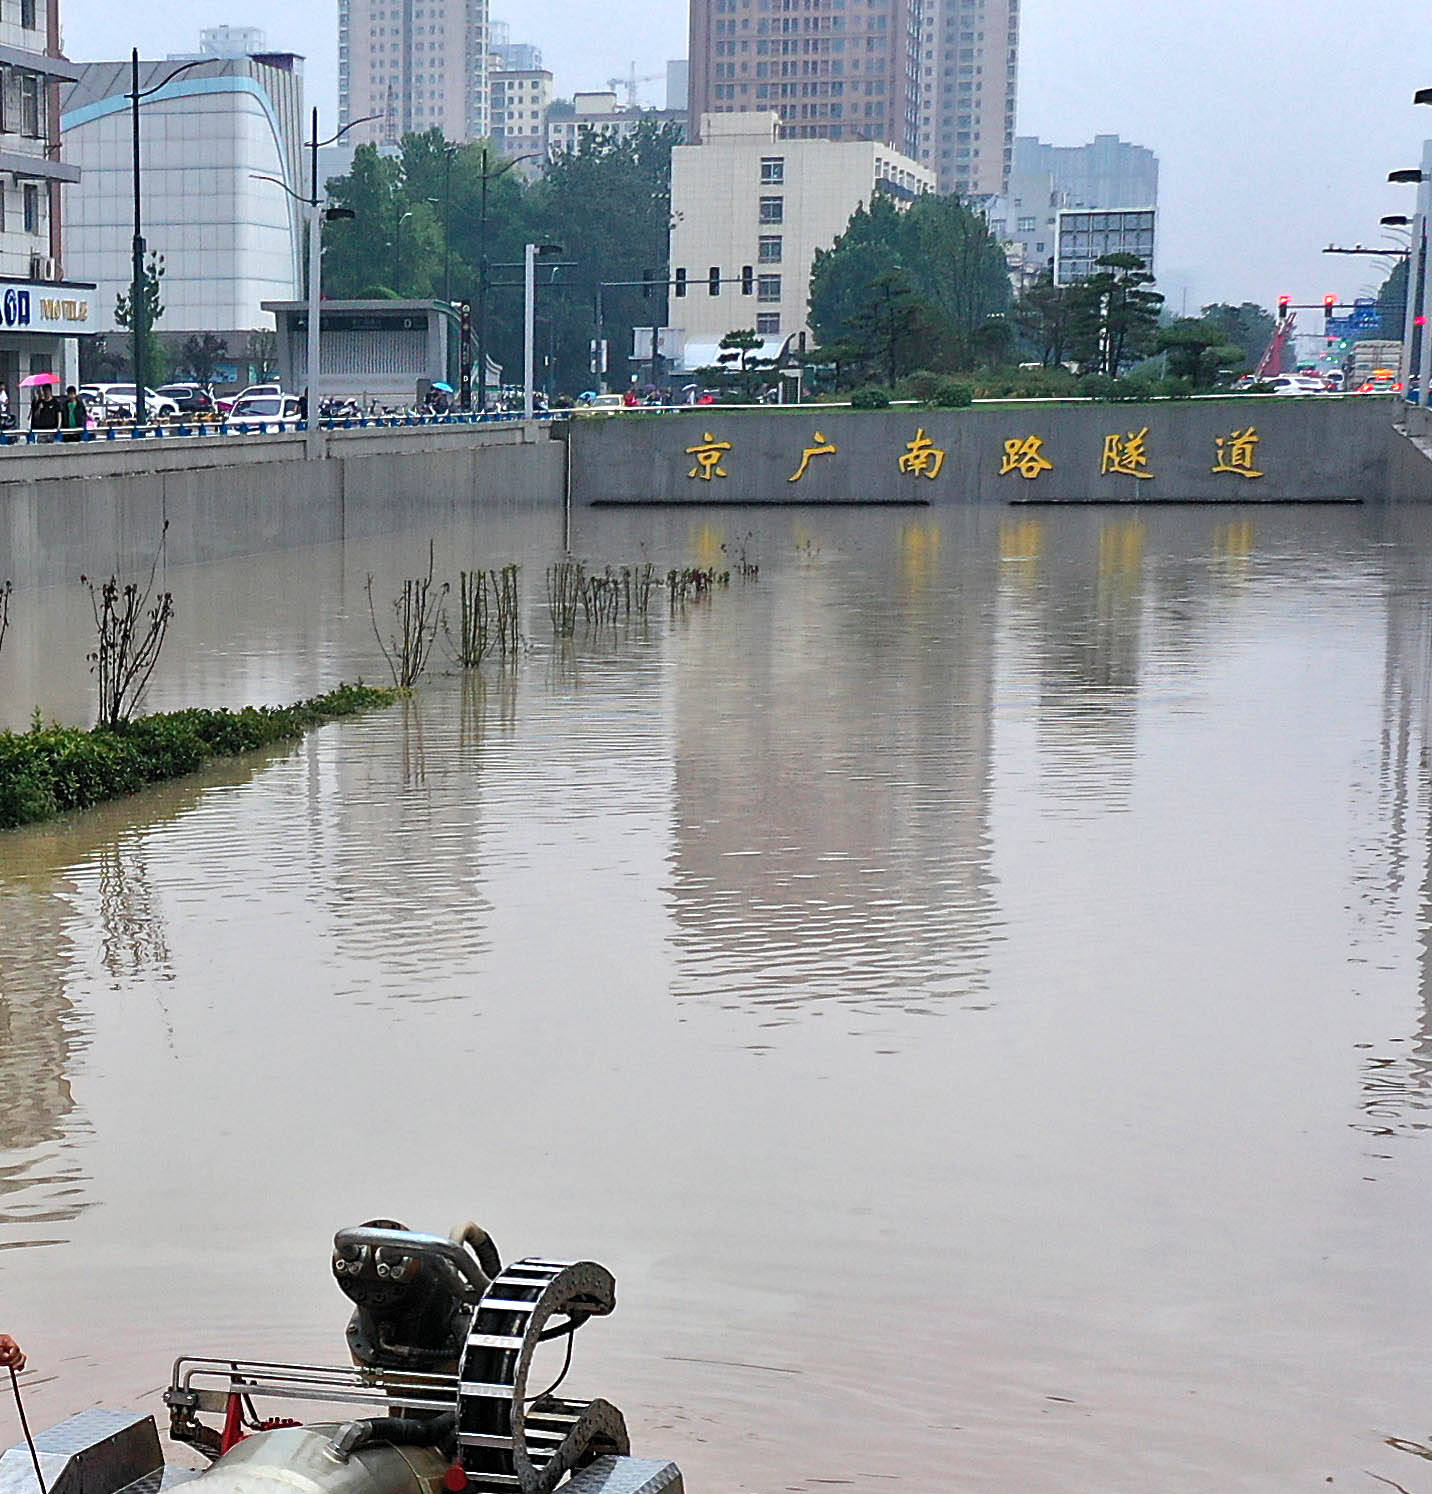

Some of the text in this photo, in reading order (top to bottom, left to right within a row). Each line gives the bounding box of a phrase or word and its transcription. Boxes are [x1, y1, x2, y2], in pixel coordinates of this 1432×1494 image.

[685, 427, 1264, 483] 京广南路隧道
